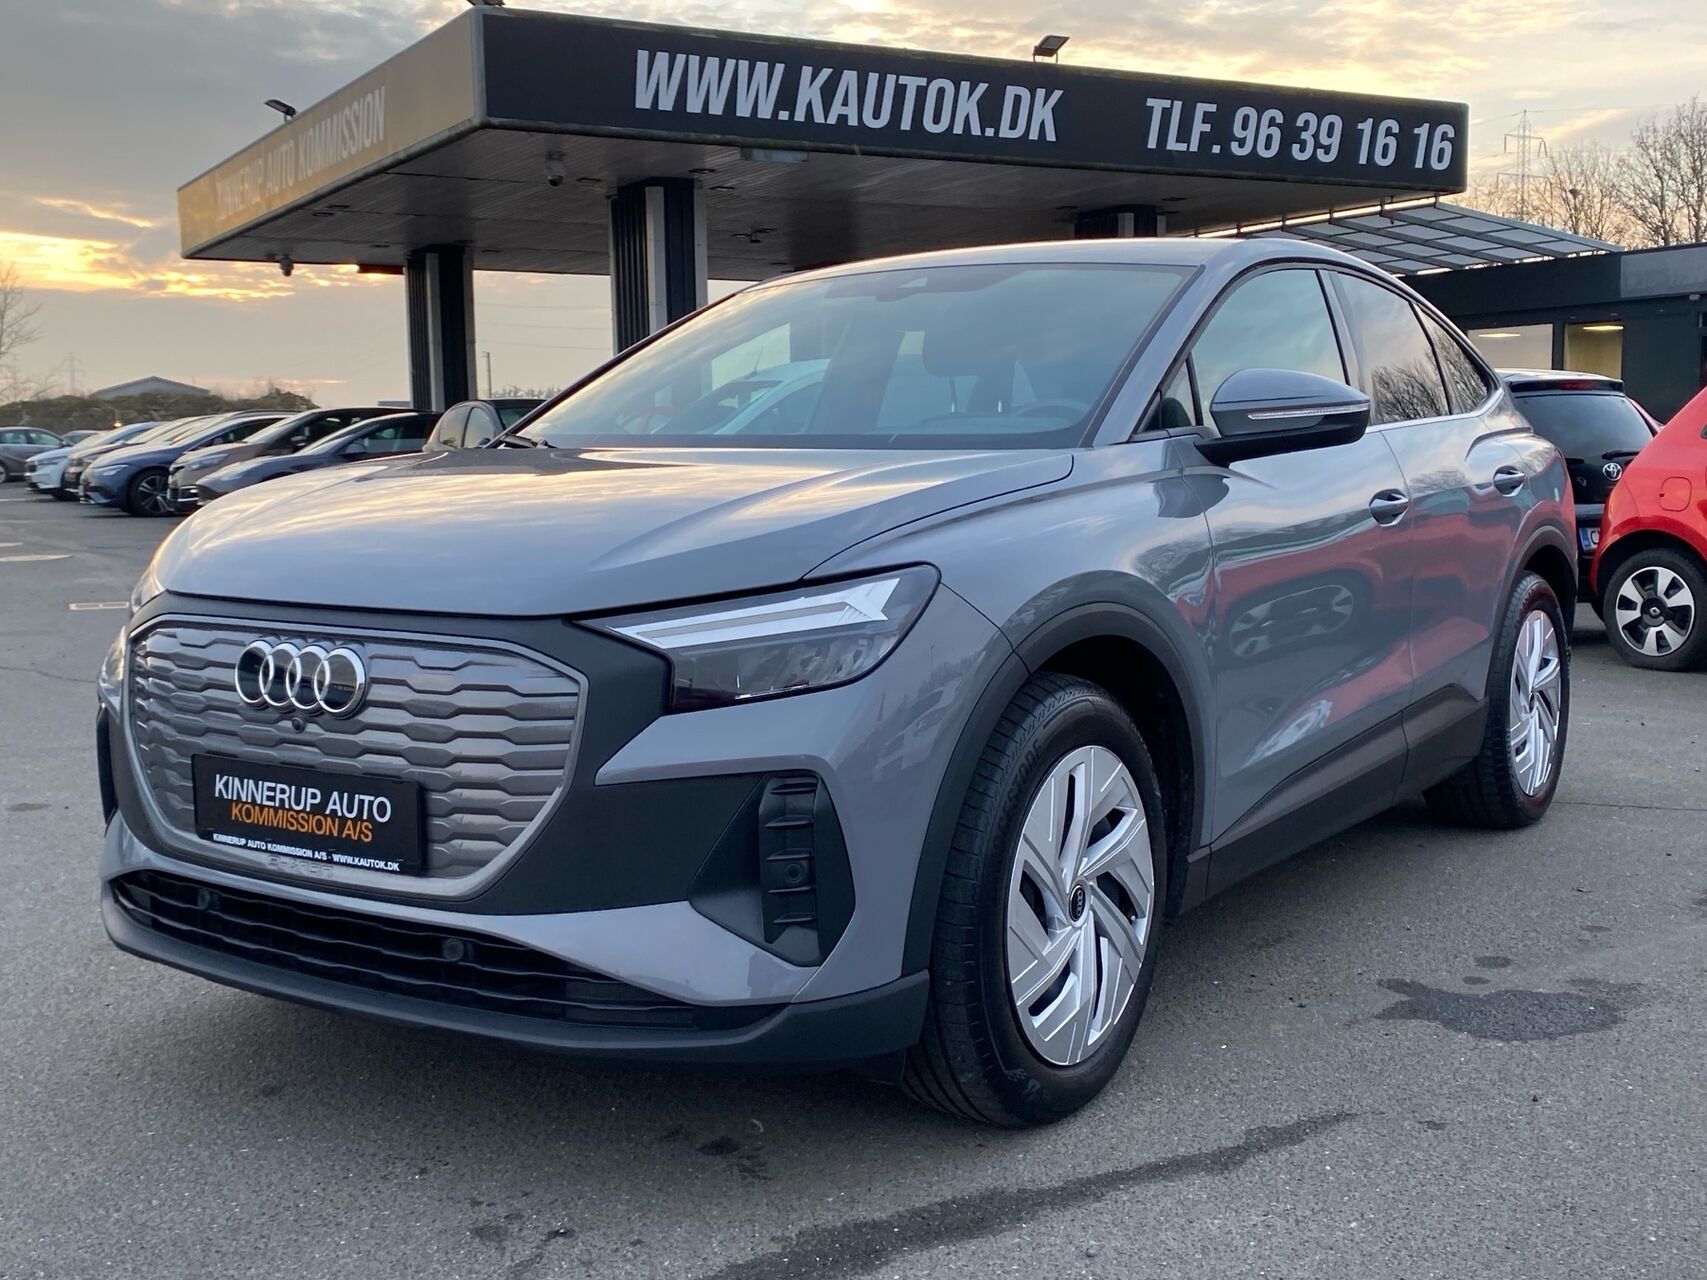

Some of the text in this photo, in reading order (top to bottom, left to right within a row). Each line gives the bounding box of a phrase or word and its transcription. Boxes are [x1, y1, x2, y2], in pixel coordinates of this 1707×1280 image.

[635, 49, 1064, 142] WWW.KAUTOK.DK
[297, 86, 386, 182] KOMMISSION
[1146, 98, 1456, 171] TLF. 96 39 16 16
[214, 774, 392, 823] KINNERUP AUTO
[231, 803, 373, 842] KOMMISSION A/S
[213, 833, 246, 847] KINNERUP
[247, 839, 267, 851] AUTO
[267, 842, 313, 859] KOMMISSION
[314, 851, 328, 861] A/S
[332, 853, 400, 872] WWW.KAUTOK.DK
